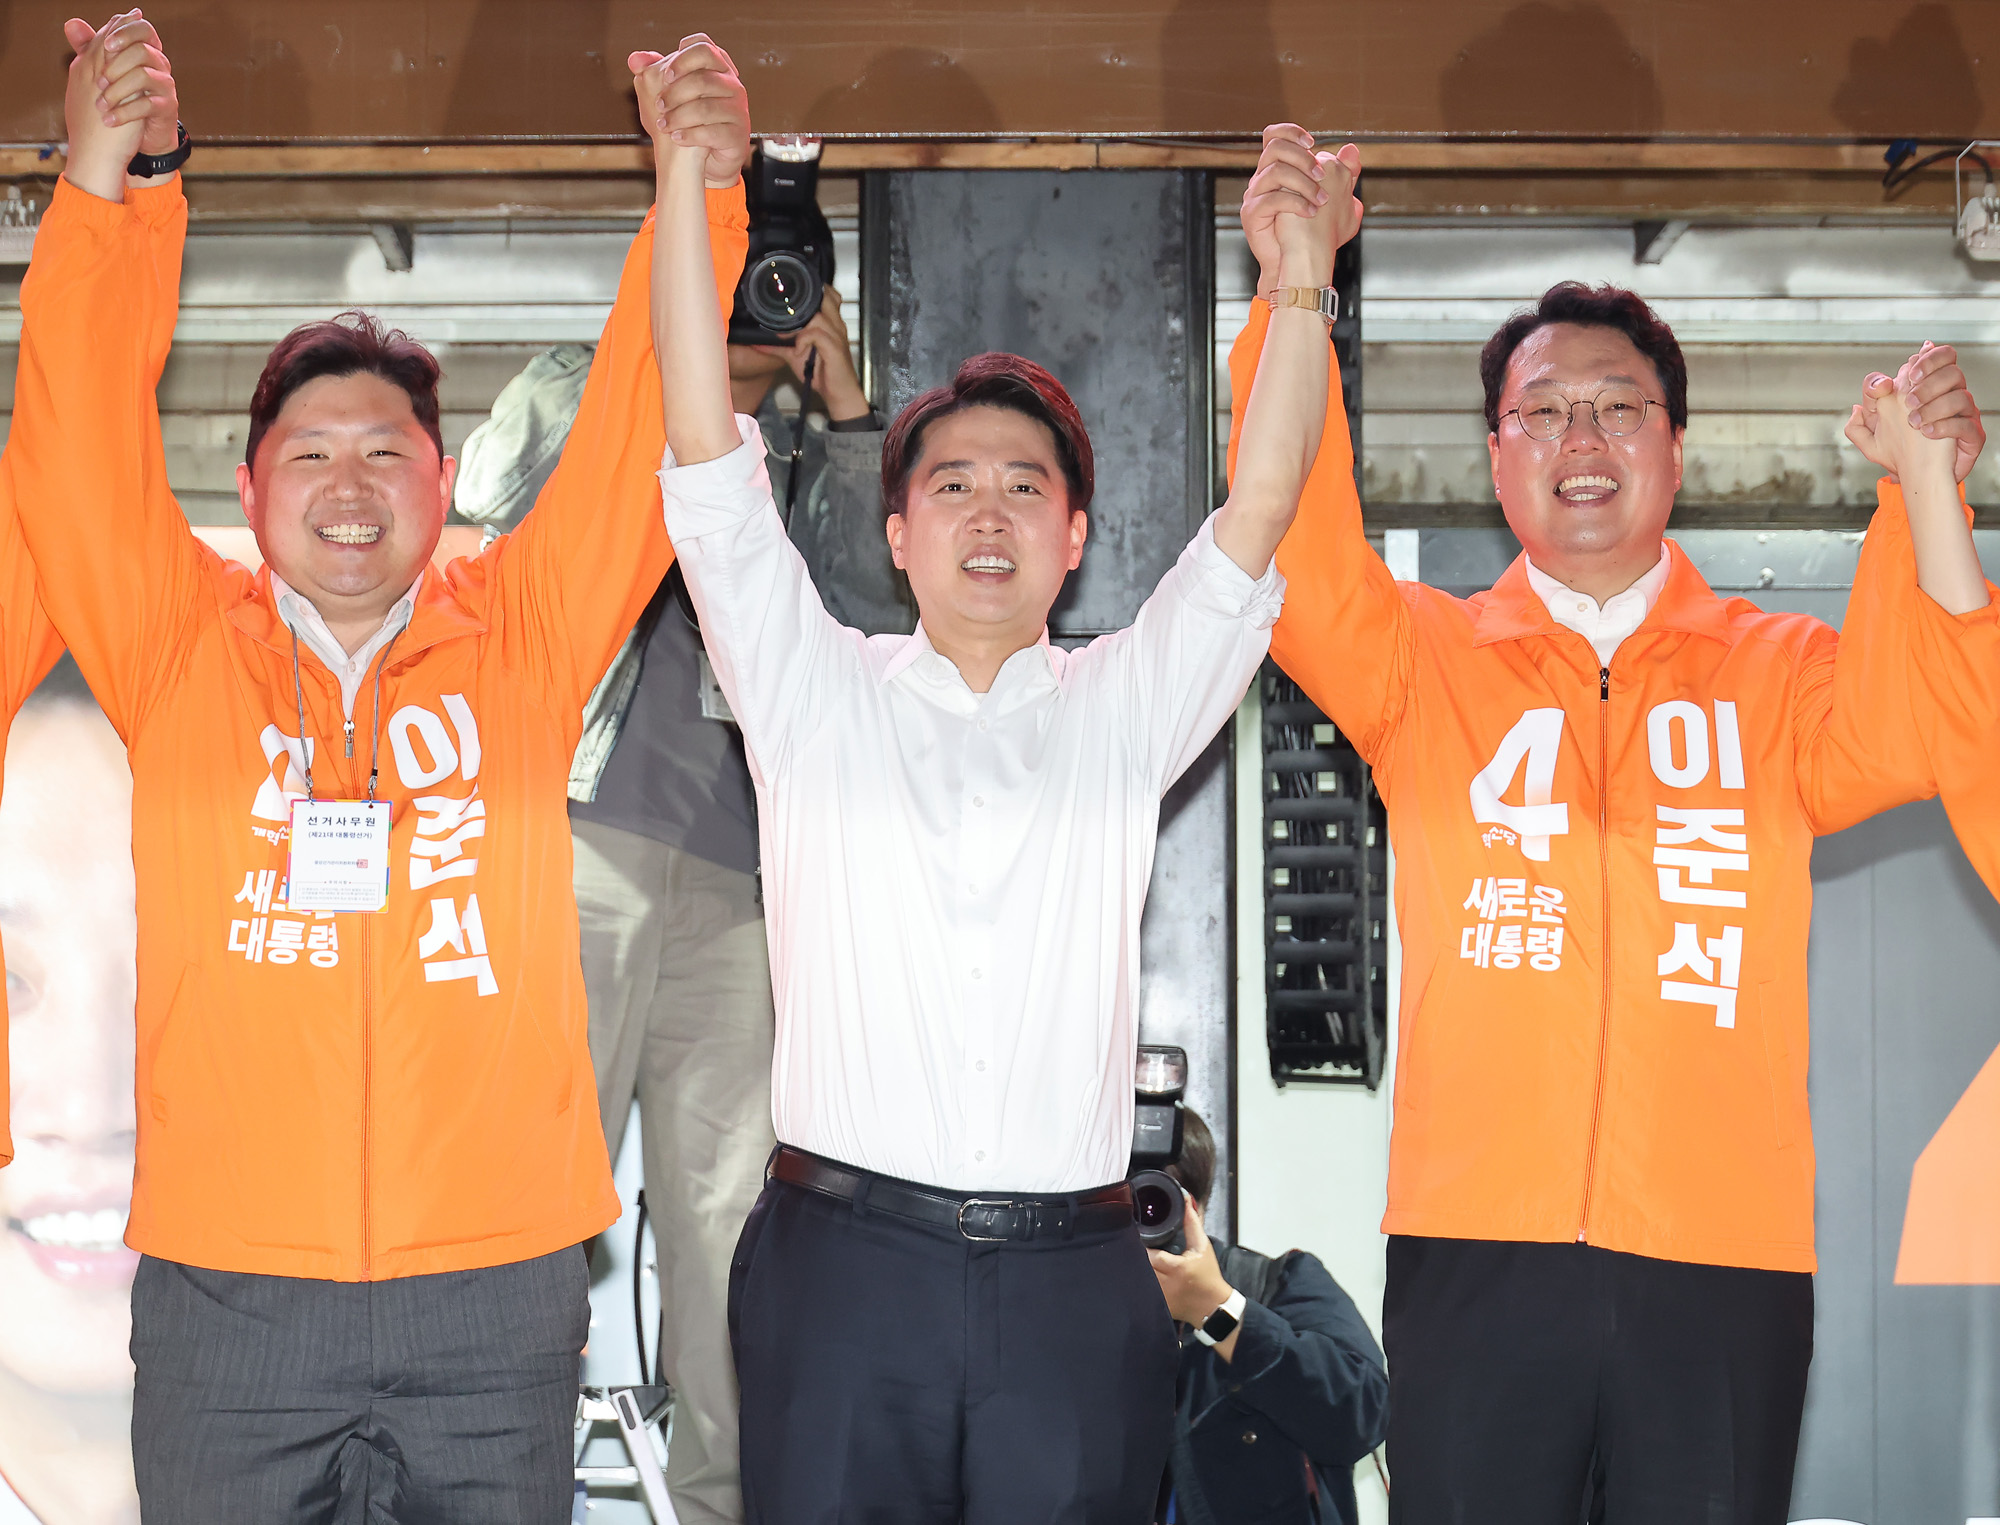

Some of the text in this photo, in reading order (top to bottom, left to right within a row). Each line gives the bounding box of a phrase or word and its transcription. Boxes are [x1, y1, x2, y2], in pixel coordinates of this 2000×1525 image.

[1469, 707, 1569, 862] 4
[251, 825, 289, 846] 개혁신
[335, 831, 373, 839] 대통령선거)
[388, 693, 499, 997] 이준석
[1647, 698, 1749, 1029] 이준석
[1463, 877, 1567, 924] 새로운
[227, 917, 340, 968] 대통령
[1460, 923, 1565, 972] 대통령
